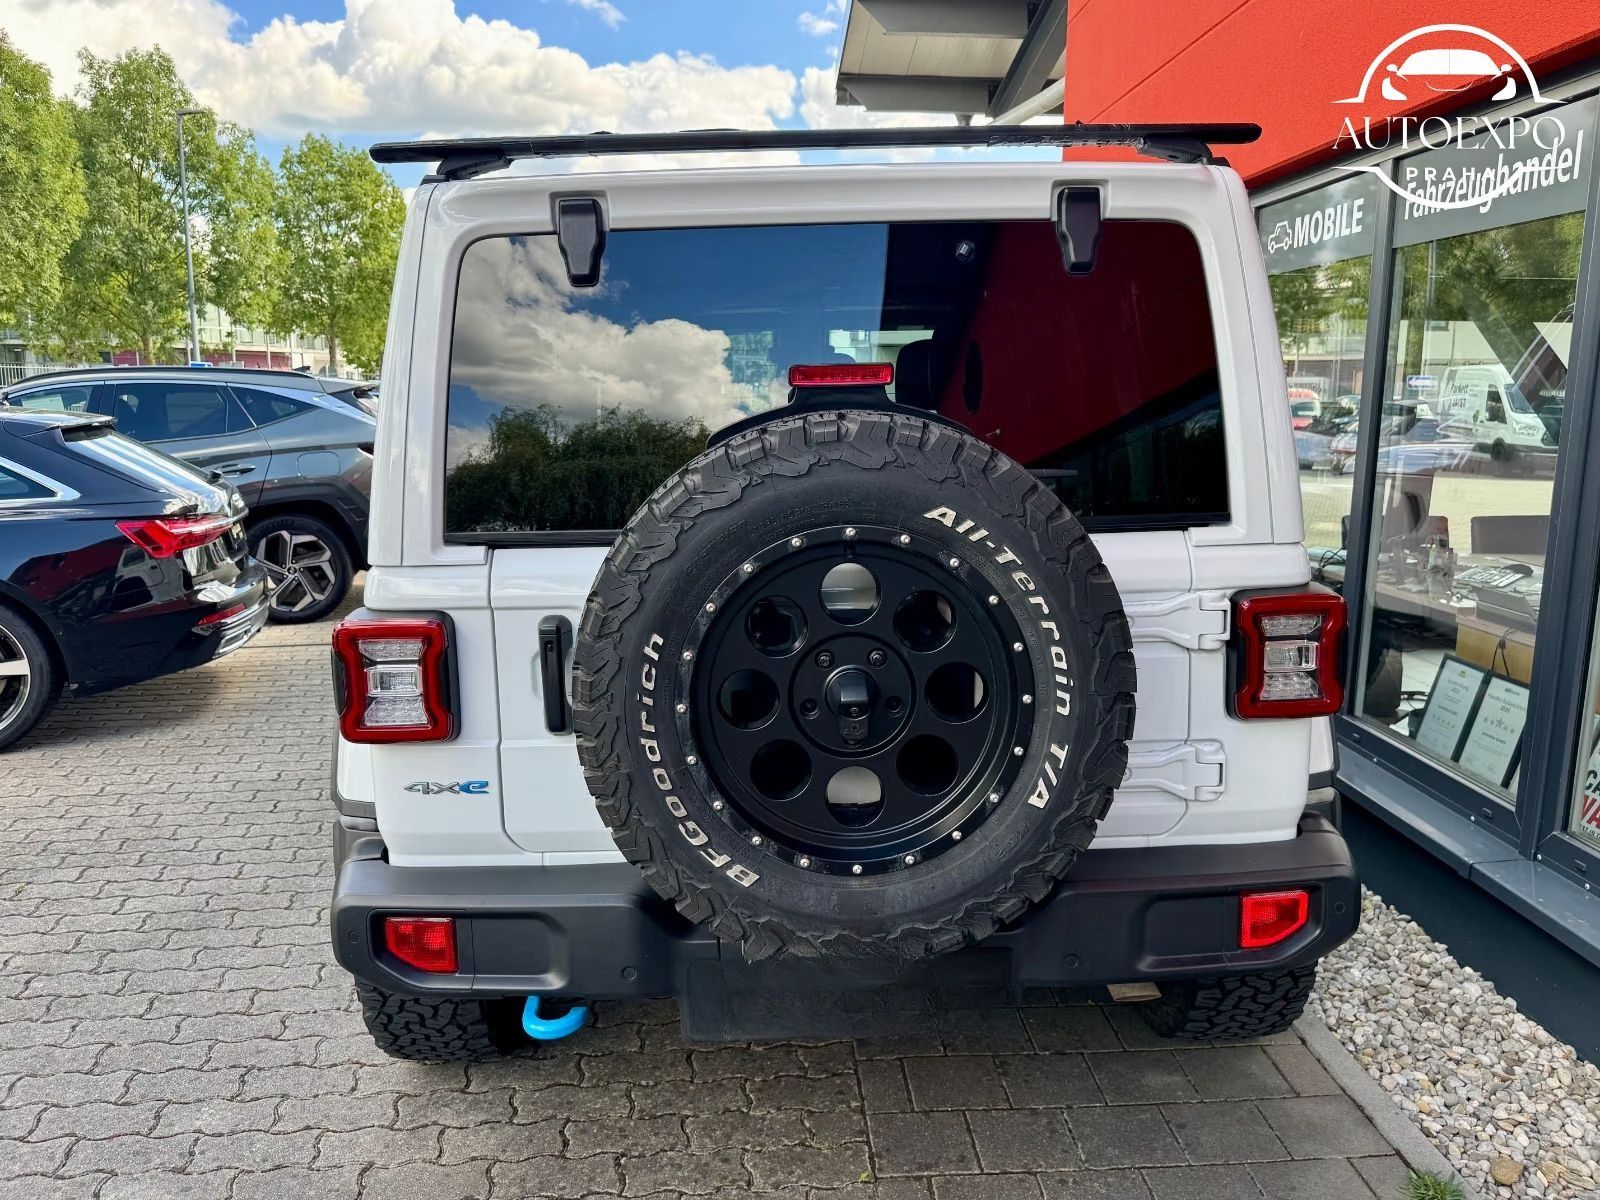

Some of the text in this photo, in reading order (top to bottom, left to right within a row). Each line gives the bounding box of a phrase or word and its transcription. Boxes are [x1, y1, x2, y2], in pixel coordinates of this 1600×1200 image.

[1293, 198, 1365, 249] MOBILE
[1404, 129, 1585, 220] Fahrzeughandel
[923, 505, 1074, 809] All-Terrain T/A
[637, 633, 760, 888] BFGoodrich
